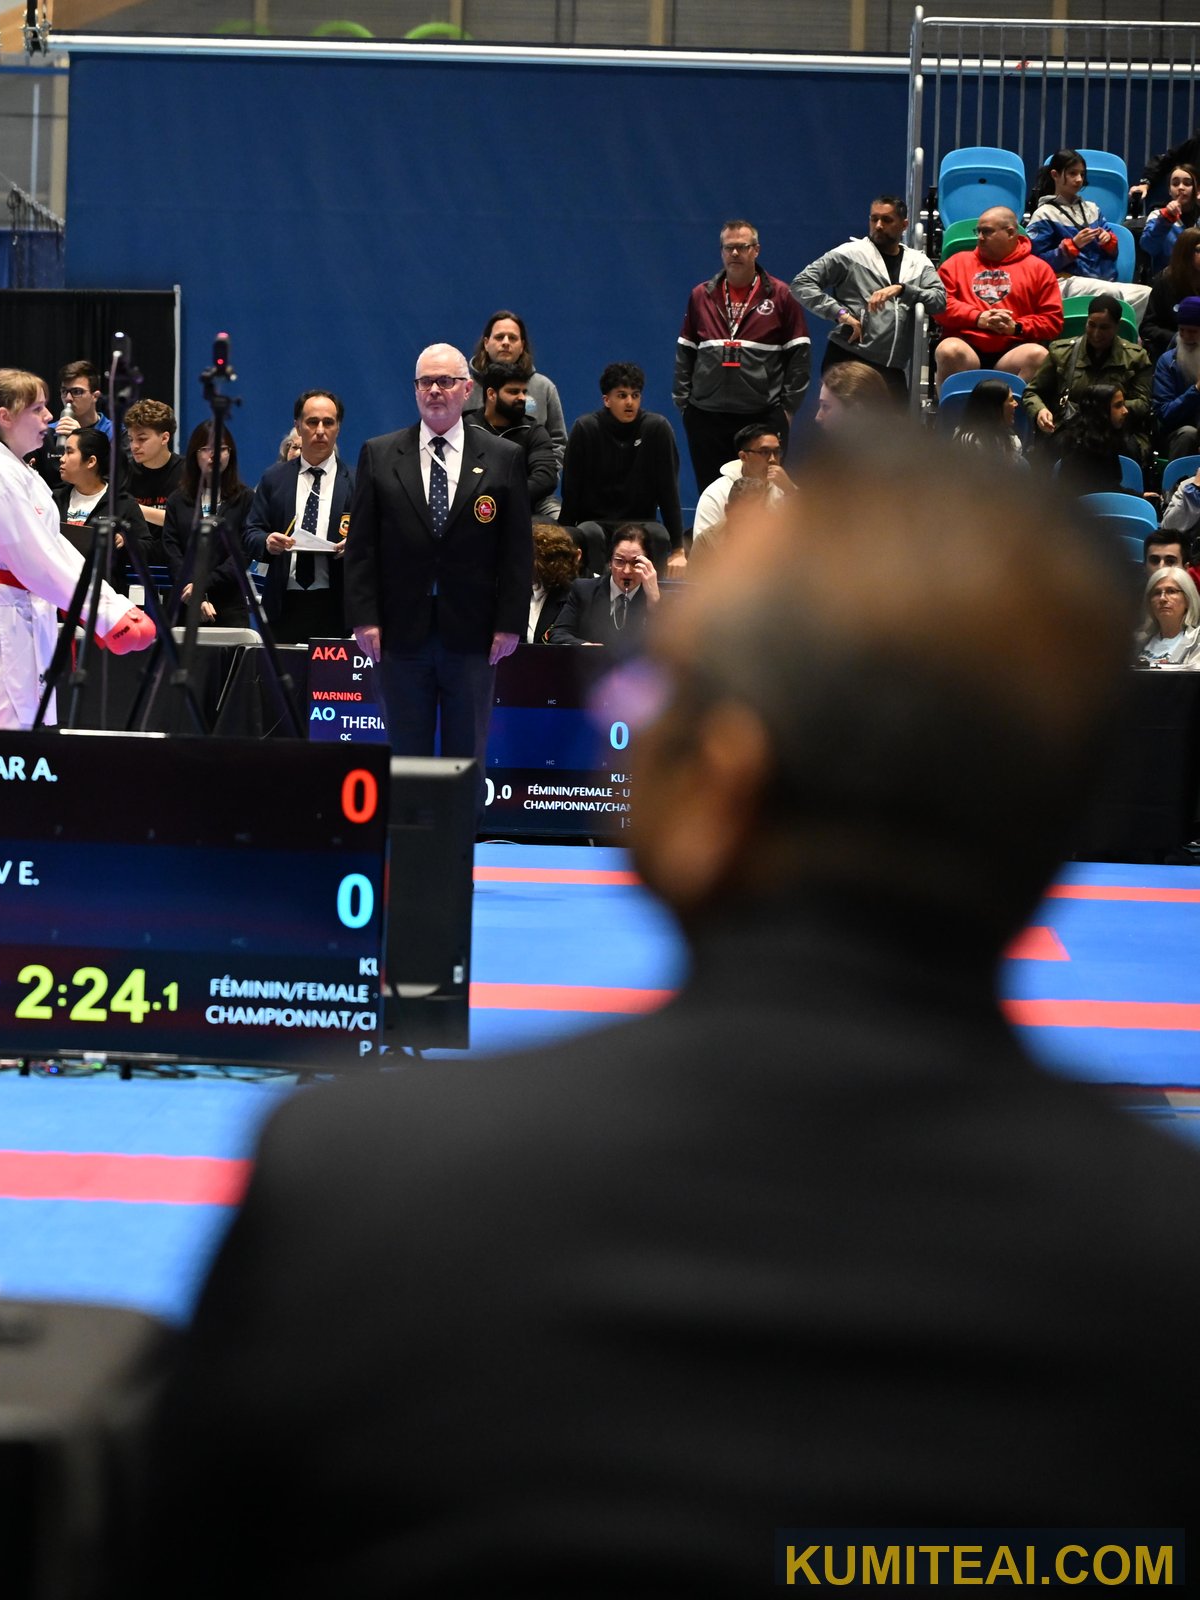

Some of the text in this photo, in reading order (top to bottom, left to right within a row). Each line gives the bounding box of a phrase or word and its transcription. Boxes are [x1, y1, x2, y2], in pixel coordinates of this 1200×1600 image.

[312, 646, 348, 661] AKA
[352, 673, 363, 681] BC
[312, 691, 362, 702] WARNING
[310, 707, 336, 721] AO
[340, 733, 352, 742] QC
[609, 721, 630, 751] 0
[31, 757, 59, 782] A.
[341, 768, 378, 823] 0
[527, 784, 613, 797] FÉMININ/FEMALE
[18, 861, 40, 886] E.
[336, 873, 374, 929] 0
[15, 964, 179, 1023] 2:24.1
[210, 974, 370, 1003] FÉMININ/FEMALE
